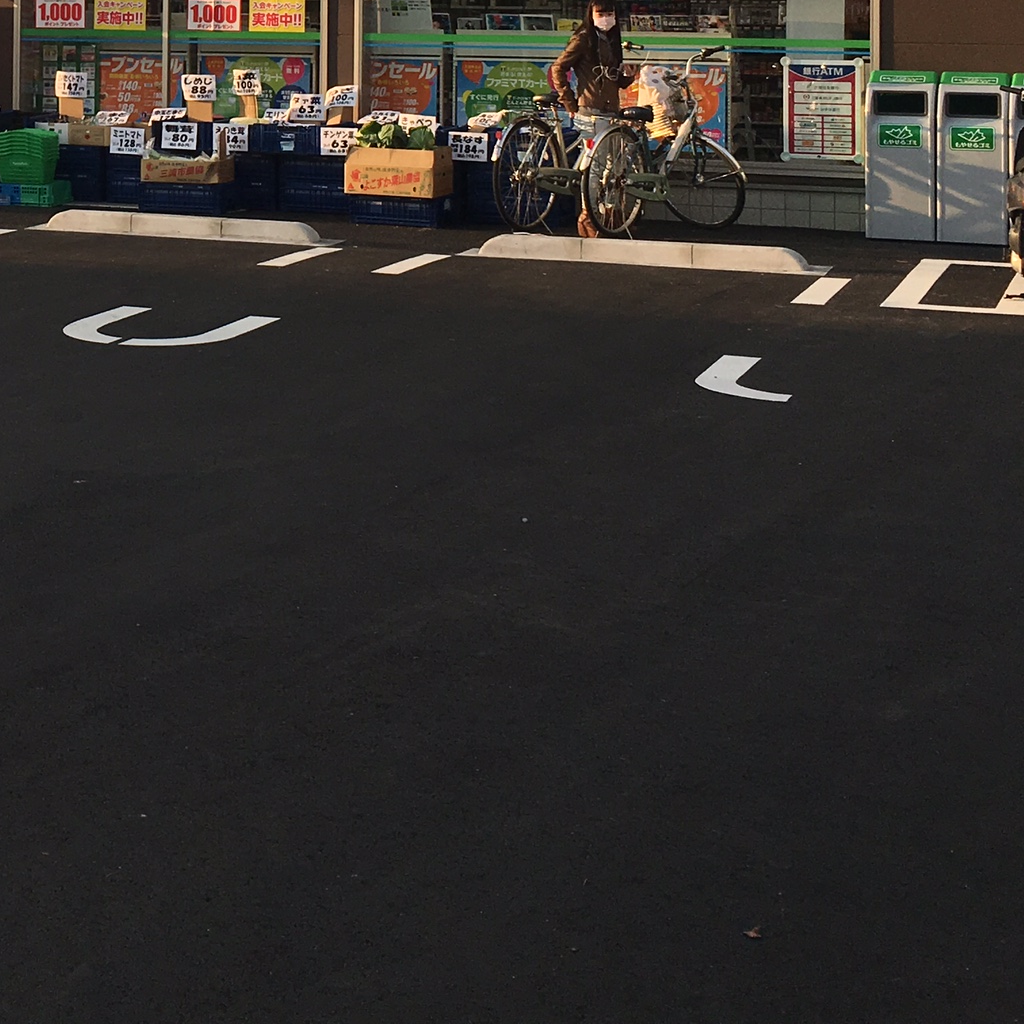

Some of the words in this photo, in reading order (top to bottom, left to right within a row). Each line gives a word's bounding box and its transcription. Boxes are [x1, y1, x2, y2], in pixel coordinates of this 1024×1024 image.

[252, 1, 303, 10] 入会キャンペーン
[38, 2, 83, 22] 1,000
[190, 4, 237, 24] 1,000
[96, 11, 143, 25] 実施中!!
[251, 12, 302, 27] 実施中!!
[100, 56, 184, 75] ープンセール
[803, 66, 844, 76] 銀行ATM
[184, 78, 213, 86] しめじ
[191, 86, 214, 95] 88円
[113, 129, 142, 139] ミニトマト
[451, 134, 484, 144] 長なす
